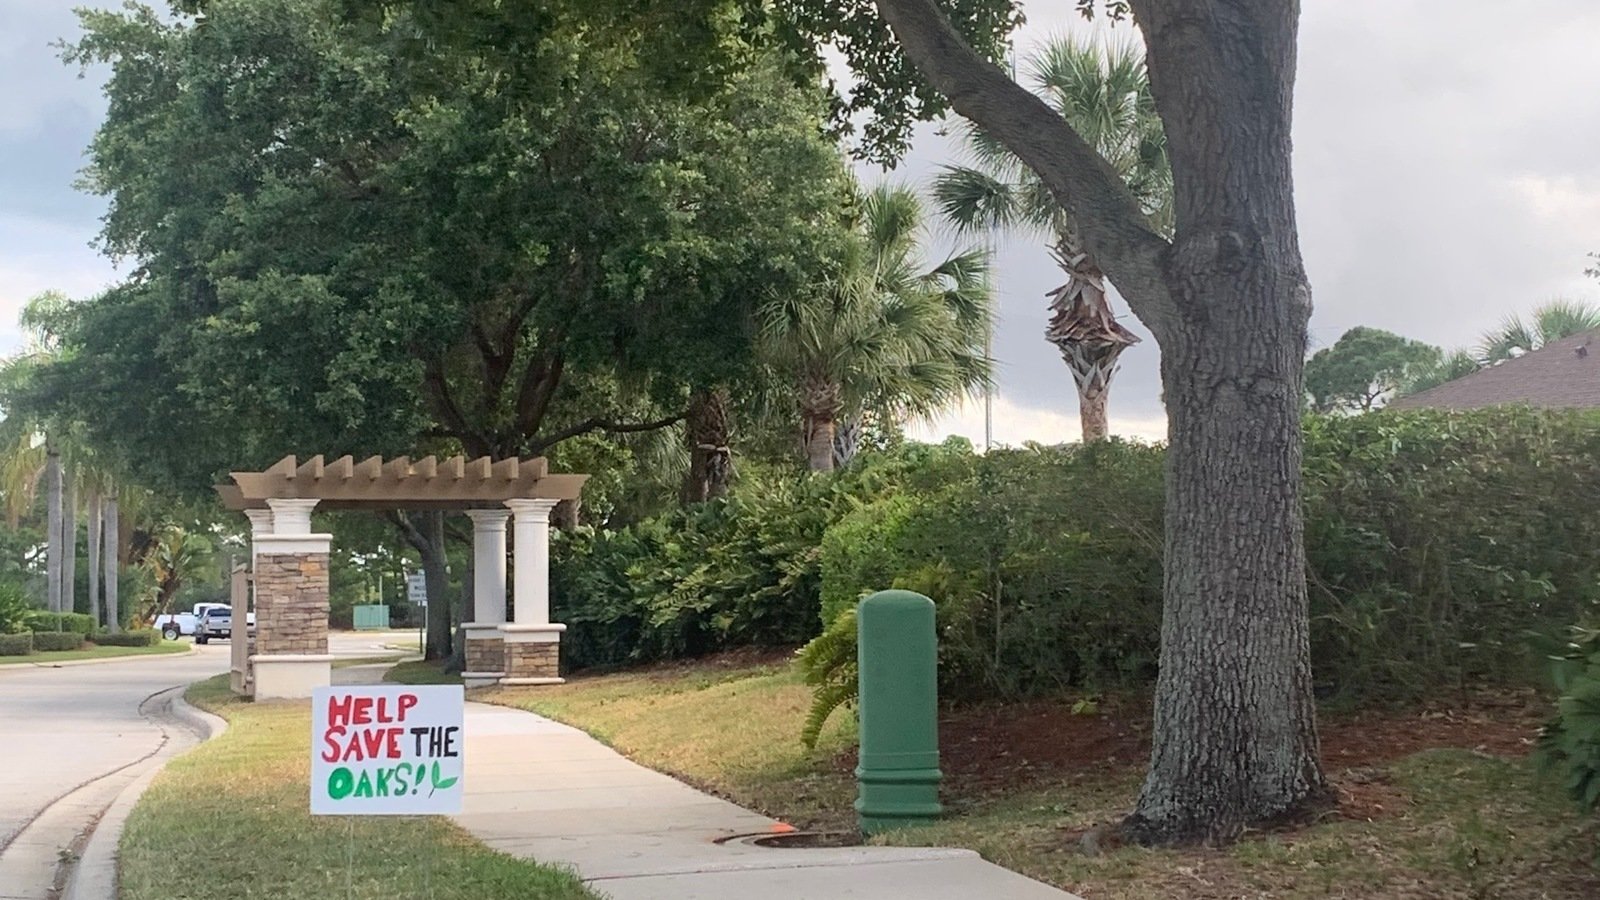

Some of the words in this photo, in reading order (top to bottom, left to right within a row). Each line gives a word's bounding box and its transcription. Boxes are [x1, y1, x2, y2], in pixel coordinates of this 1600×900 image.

[328, 695, 418, 727] HELP
[321, 725, 405, 763] SAVE
[410, 726, 459, 758] THE
[327, 762, 426, 800] OAKS!
